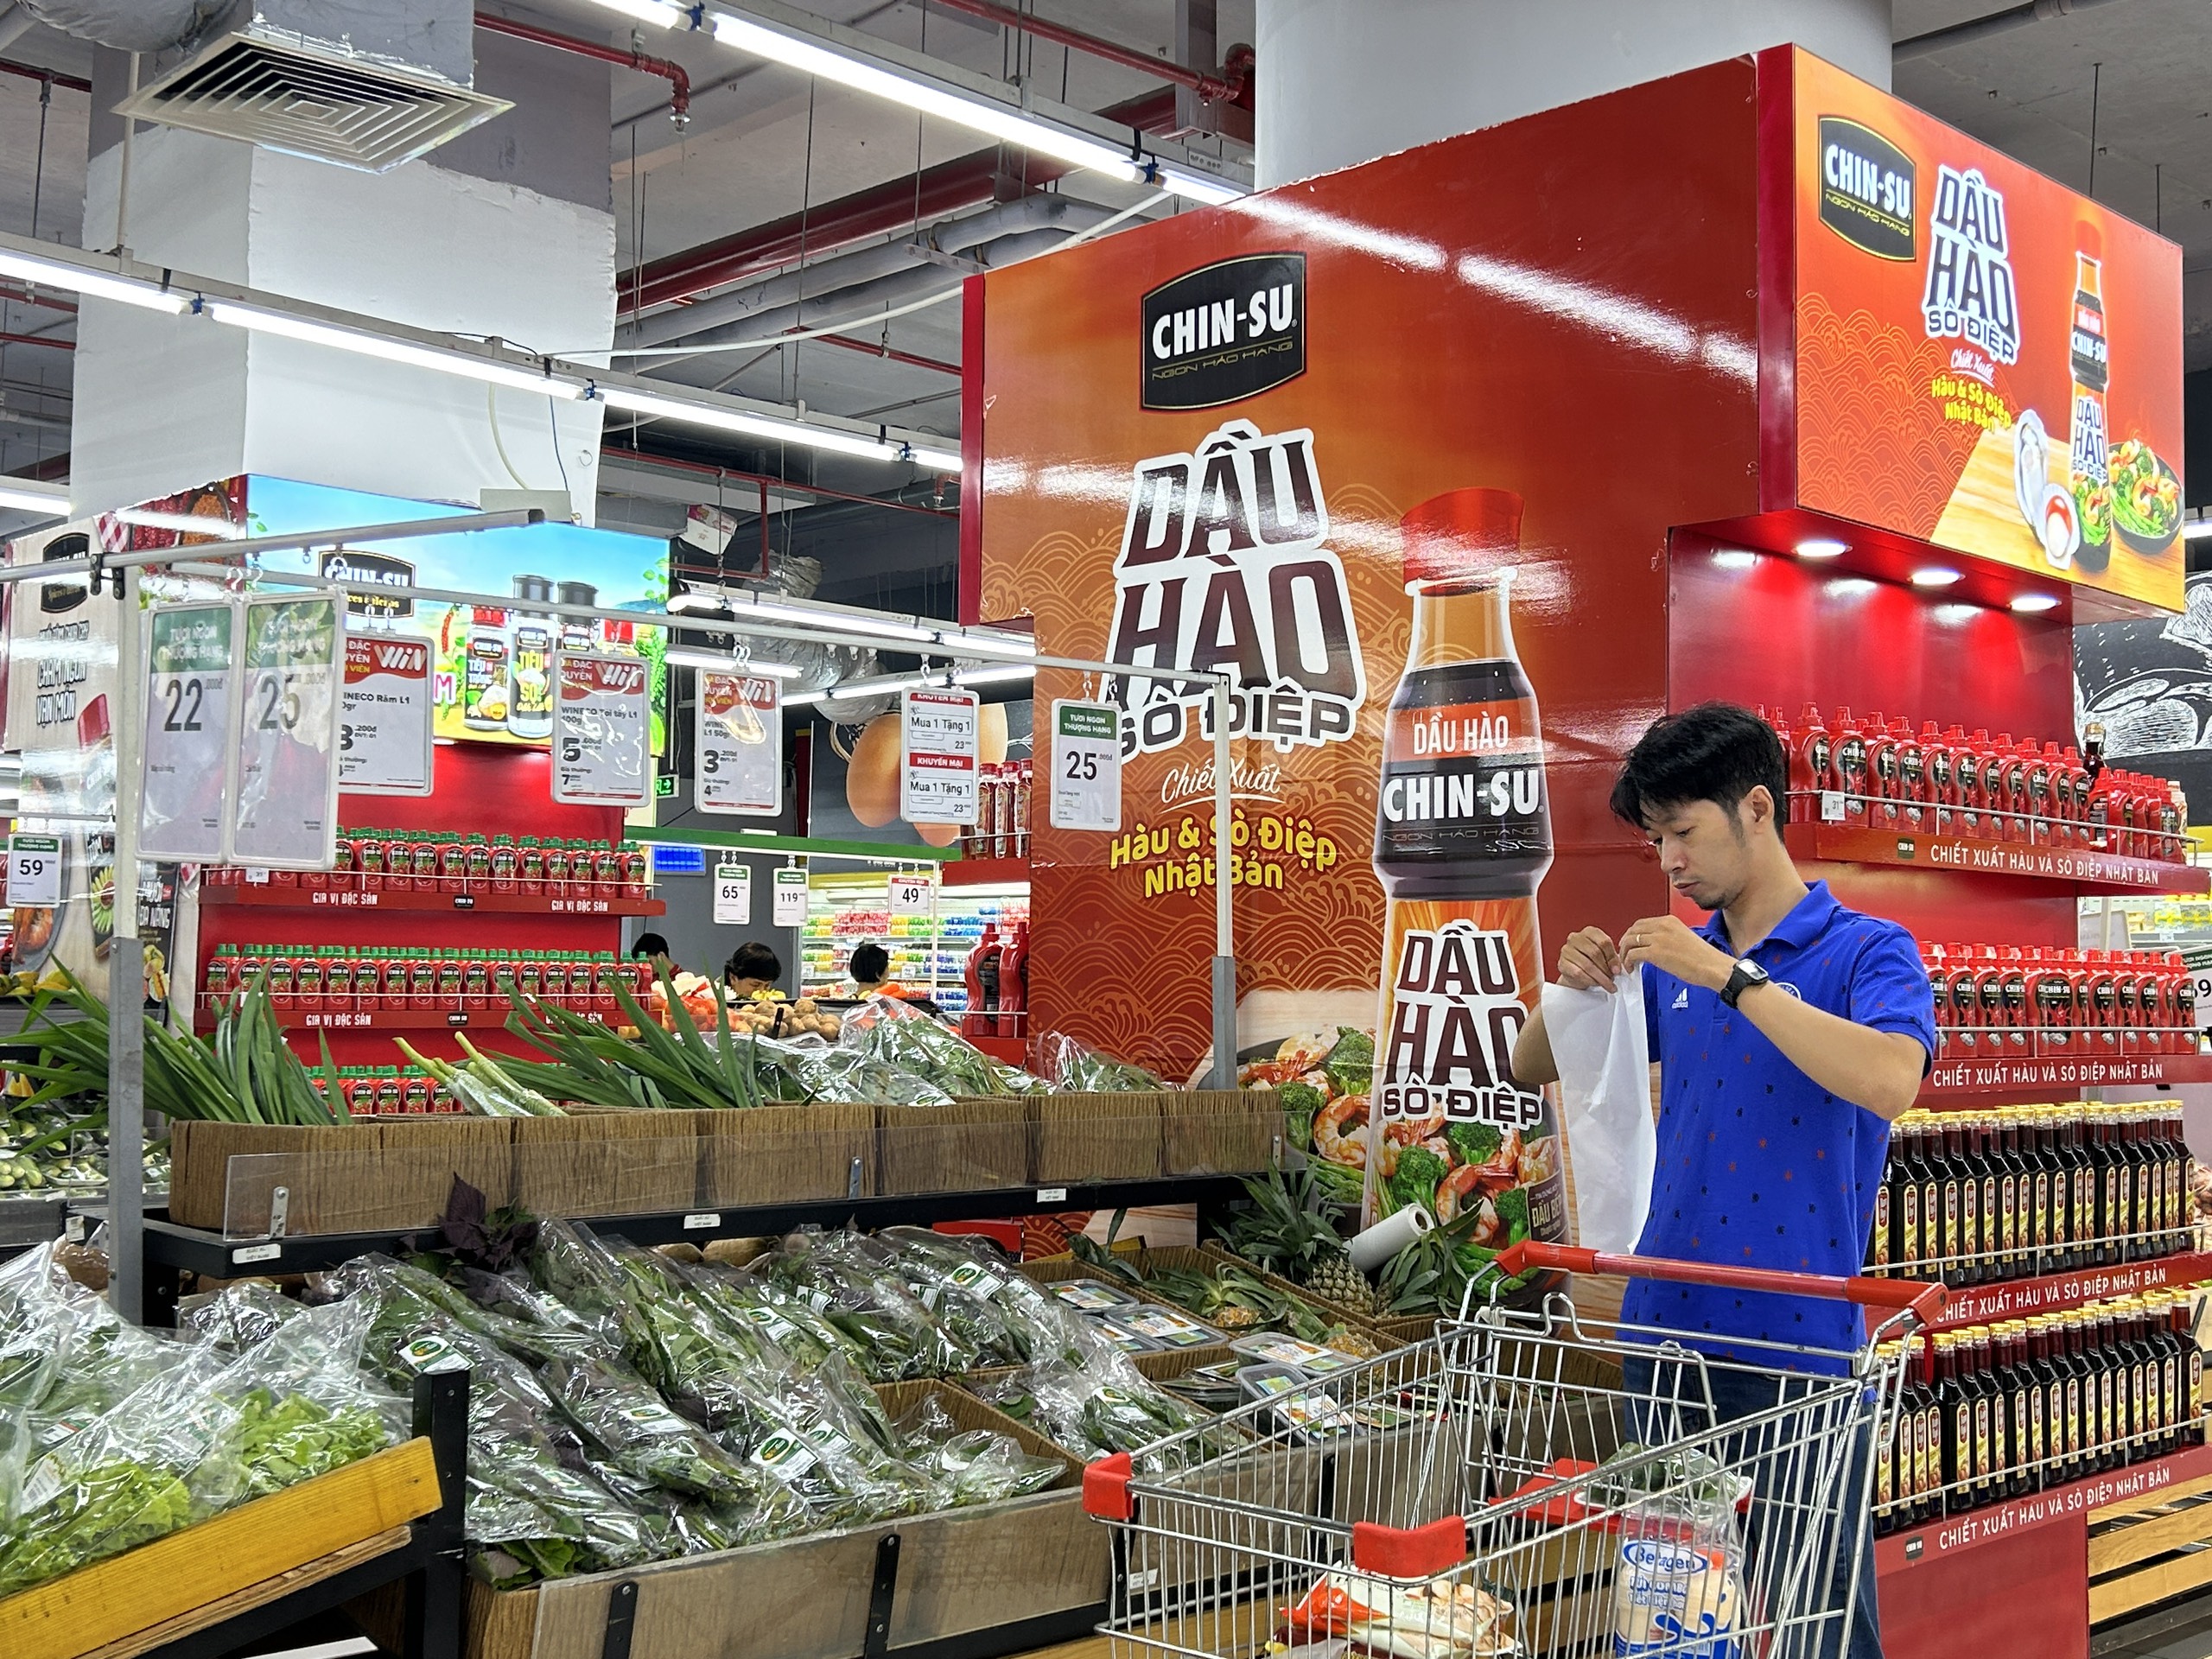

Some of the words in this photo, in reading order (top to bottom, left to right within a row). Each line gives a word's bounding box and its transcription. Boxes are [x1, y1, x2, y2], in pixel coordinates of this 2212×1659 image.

[1826, 144, 1910, 219] CHIN-SU
[1936, 172, 2005, 254] DẦU
[1926, 233, 2017, 344] HÀO
[1153, 283, 1294, 360] CHIN-SU
[1929, 297, 1959, 333] SÒ
[1967, 316, 2014, 360] ĐIỆP
[2071, 331, 2107, 363] CHIN-SU
[1152, 363, 1198, 380] NGON
[1931, 374, 1956, 397] Hàu
[1957, 379, 1967, 398] &
[1968, 383, 1984, 405] Sò
[2077, 398, 2101, 430] DẦU
[1123, 430, 1326, 568] DẦU
[1113, 556, 1357, 709] HÀO
[164, 678, 203, 731] 22
[259, 674, 302, 730] 25
[343, 691, 375, 702] INECO
[911, 716, 931, 728] Mua
[933, 718, 938, 728] 1
[942, 718, 963, 732] Tặng
[965, 721, 970, 731] 1
[1205, 683, 1351, 745] ĐIỆP
[955, 741, 964, 750] 23
[1414, 711, 1456, 755] DẦU
[1463, 710, 1509, 752] HÀO
[563, 737, 581, 762] 5
[704, 750, 720, 773] 3
[918, 756, 948, 766] KHUYẾN
[1066, 750, 1097, 780] 25
[910, 781, 930, 792] Mua
[932, 782, 938, 792] 1
[941, 782, 963, 796] Tặng
[964, 785, 969, 794] 1
[1161, 757, 1217, 804] Chiết
[1382, 769, 1539, 823] CHIN-SU
[953, 804, 964, 813] 23
[1111, 823, 1169, 869] Hàu
[1178, 817, 1201, 849] &
[1259, 817, 1337, 872] Điệp
[1382, 831, 1433, 842] NGON
[19, 859, 44, 876] 59
[1145, 852, 1217, 897] Nhật
[1930, 841, 1968, 865] CHIẾT
[1973, 844, 2005, 869] XUẤT
[2009, 850, 2035, 873] HÀU
[2038, 855, 2054, 874] VÀ
[2057, 856, 2073, 876] SÒ
[2076, 858, 2103, 882] ĐIỆP
[2106, 861, 2135, 887] NHẬT
[2138, 864, 2159, 885] BẢN
[312, 892, 327, 905] GIA
[329, 893, 339, 906] VỊ
[341, 892, 358, 906] ĐẶC
[360, 892, 378, 906] SẢN
[551, 899, 563, 912] GIA
[566, 900, 575, 912] VỊ
[576, 901, 592, 912] ĐẶC
[593, 900, 608, 912] SẢN
[722, 885, 739, 899] 65
[780, 893, 798, 903] 119
[902, 887, 918, 904] 49
[1397, 925, 1515, 995] DẦU
[306, 1014, 321, 1027] GIA
[323, 1014, 333, 1027] VỊ
[334, 1014, 352, 1027] ĐẶC
[354, 1013, 372, 1027] SẢN
[1933, 1062, 1972, 1087] CHIẾT
[1975, 1061, 2008, 1085] XUẤT
[2012, 1061, 2037, 1083] HÀU
[2042, 1062, 2056, 1082] VÀ
[2061, 1062, 2076, 1081] SÒ
[2080, 1059, 2106, 1082] ĐIỆP
[2109, 1059, 2138, 1084] NHẬT
[2141, 1057, 2163, 1079] BẢN
[1383, 1072, 1429, 1116] SÒ
[1446, 1084, 1541, 1130] ĐIỆP
[1979, 1287, 2012, 1315] XUẤT
[2016, 1285, 2042, 1309] HÀU
[2045, 1281, 2060, 1302] VÀ
[2064, 1279, 2080, 1300] SÒ
[2083, 1274, 2109, 1297] ĐIỆP
[2113, 1268, 2140, 1294] NHẬT
[2144, 1262, 2166, 1285] BẢN
[1939, 1516, 1978, 1550] CHIẾT
[1982, 1506, 2015, 1536] XUẤT
[2019, 1500, 2044, 1526] HÀU
[2049, 1493, 2063, 1515] VÀ
[2068, 1490, 2083, 1512] SÒ
[2087, 1483, 2111, 1507] ĐIỆP
[2115, 1476, 2145, 1500] NHẬT
[2148, 1466, 2171, 1488] BẢN
